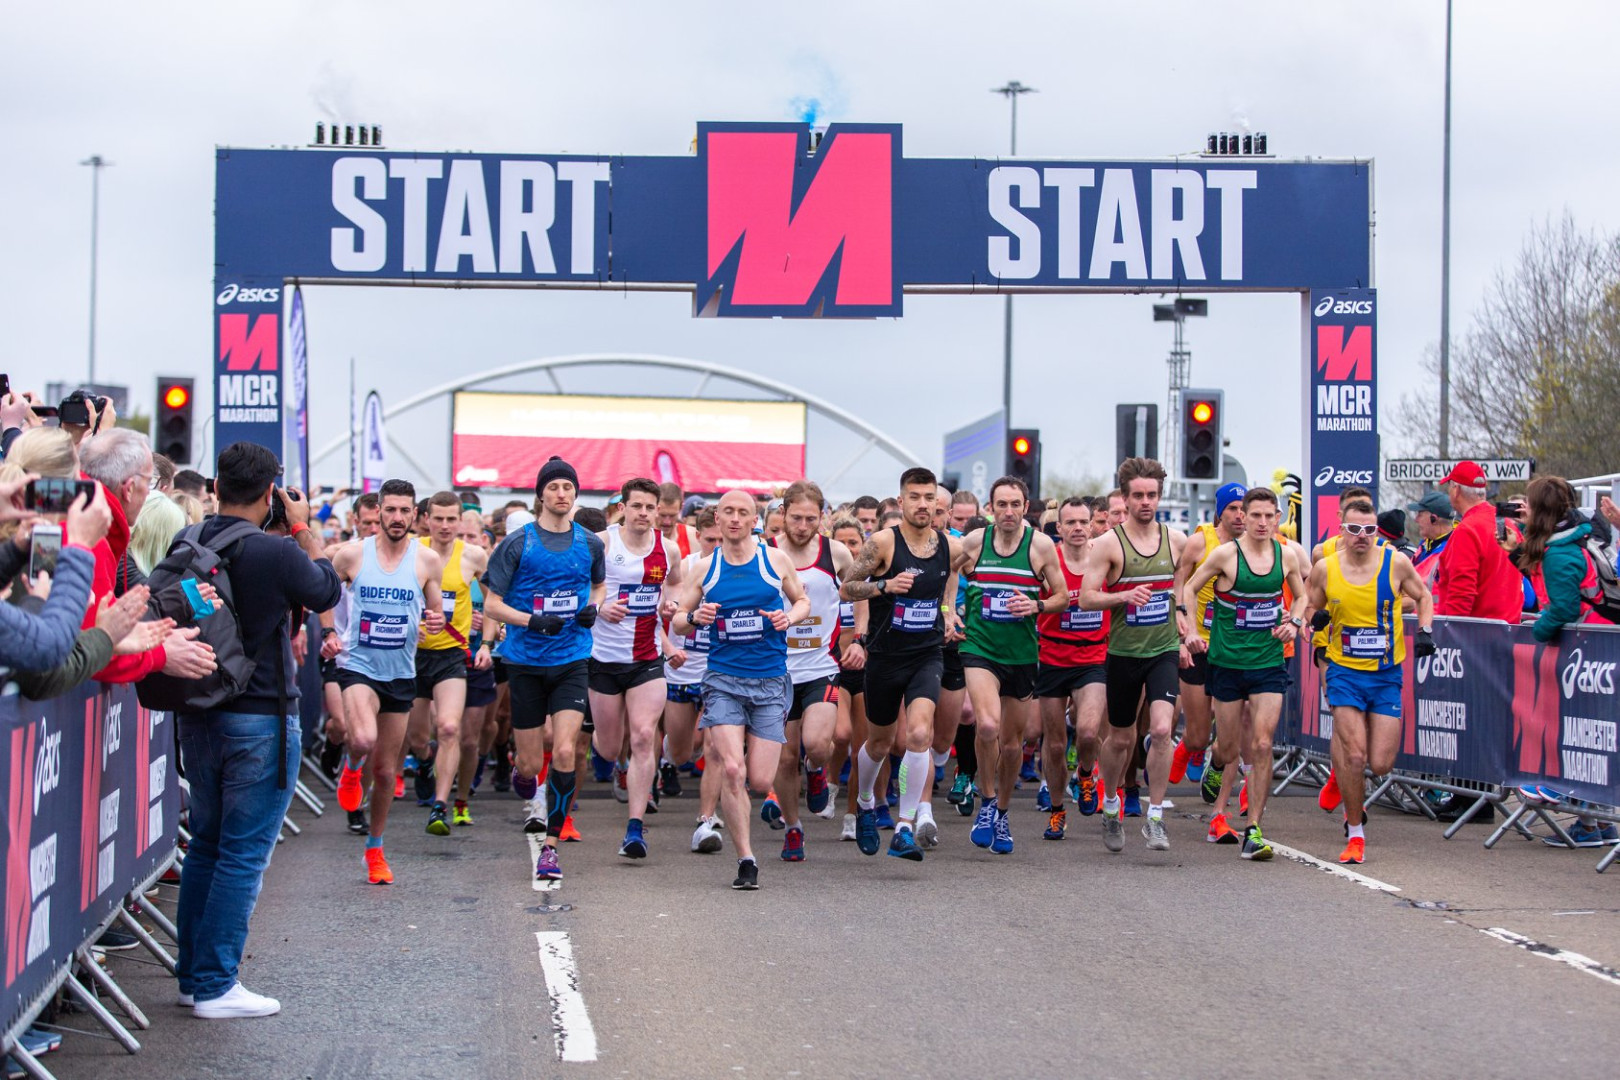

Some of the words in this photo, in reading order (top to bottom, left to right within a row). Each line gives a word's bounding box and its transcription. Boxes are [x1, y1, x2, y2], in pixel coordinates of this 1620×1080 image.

[330, 157, 610, 274] START
[988, 166, 1257, 280] START
[236, 288, 280, 302] asics
[1333, 300, 1373, 314] asics
[219, 375, 278, 406] MCR
[1317, 385, 1371, 415] MCR
[219, 408, 278, 423] MARATHON
[1317, 417, 1372, 431] MARATHON
[1333, 470, 1373, 484] asics
[1390, 463, 1489, 479] BRIDGEWR
[1495, 463, 1525, 478] WAY
[360, 586, 414, 601] BIDEFORD
[731, 619, 756, 628] CHARLES
[1357, 637, 1378, 645] PALMER
[1432, 647, 1464, 679] asics
[1577, 660, 1617, 695] asics
[1418, 699, 1466, 731] MANCHESTER
[1418, 729, 1457, 761] MARATHON
[1562, 716, 1617, 752] MANCHESTER
[1562, 750, 1608, 786] MARATHON
